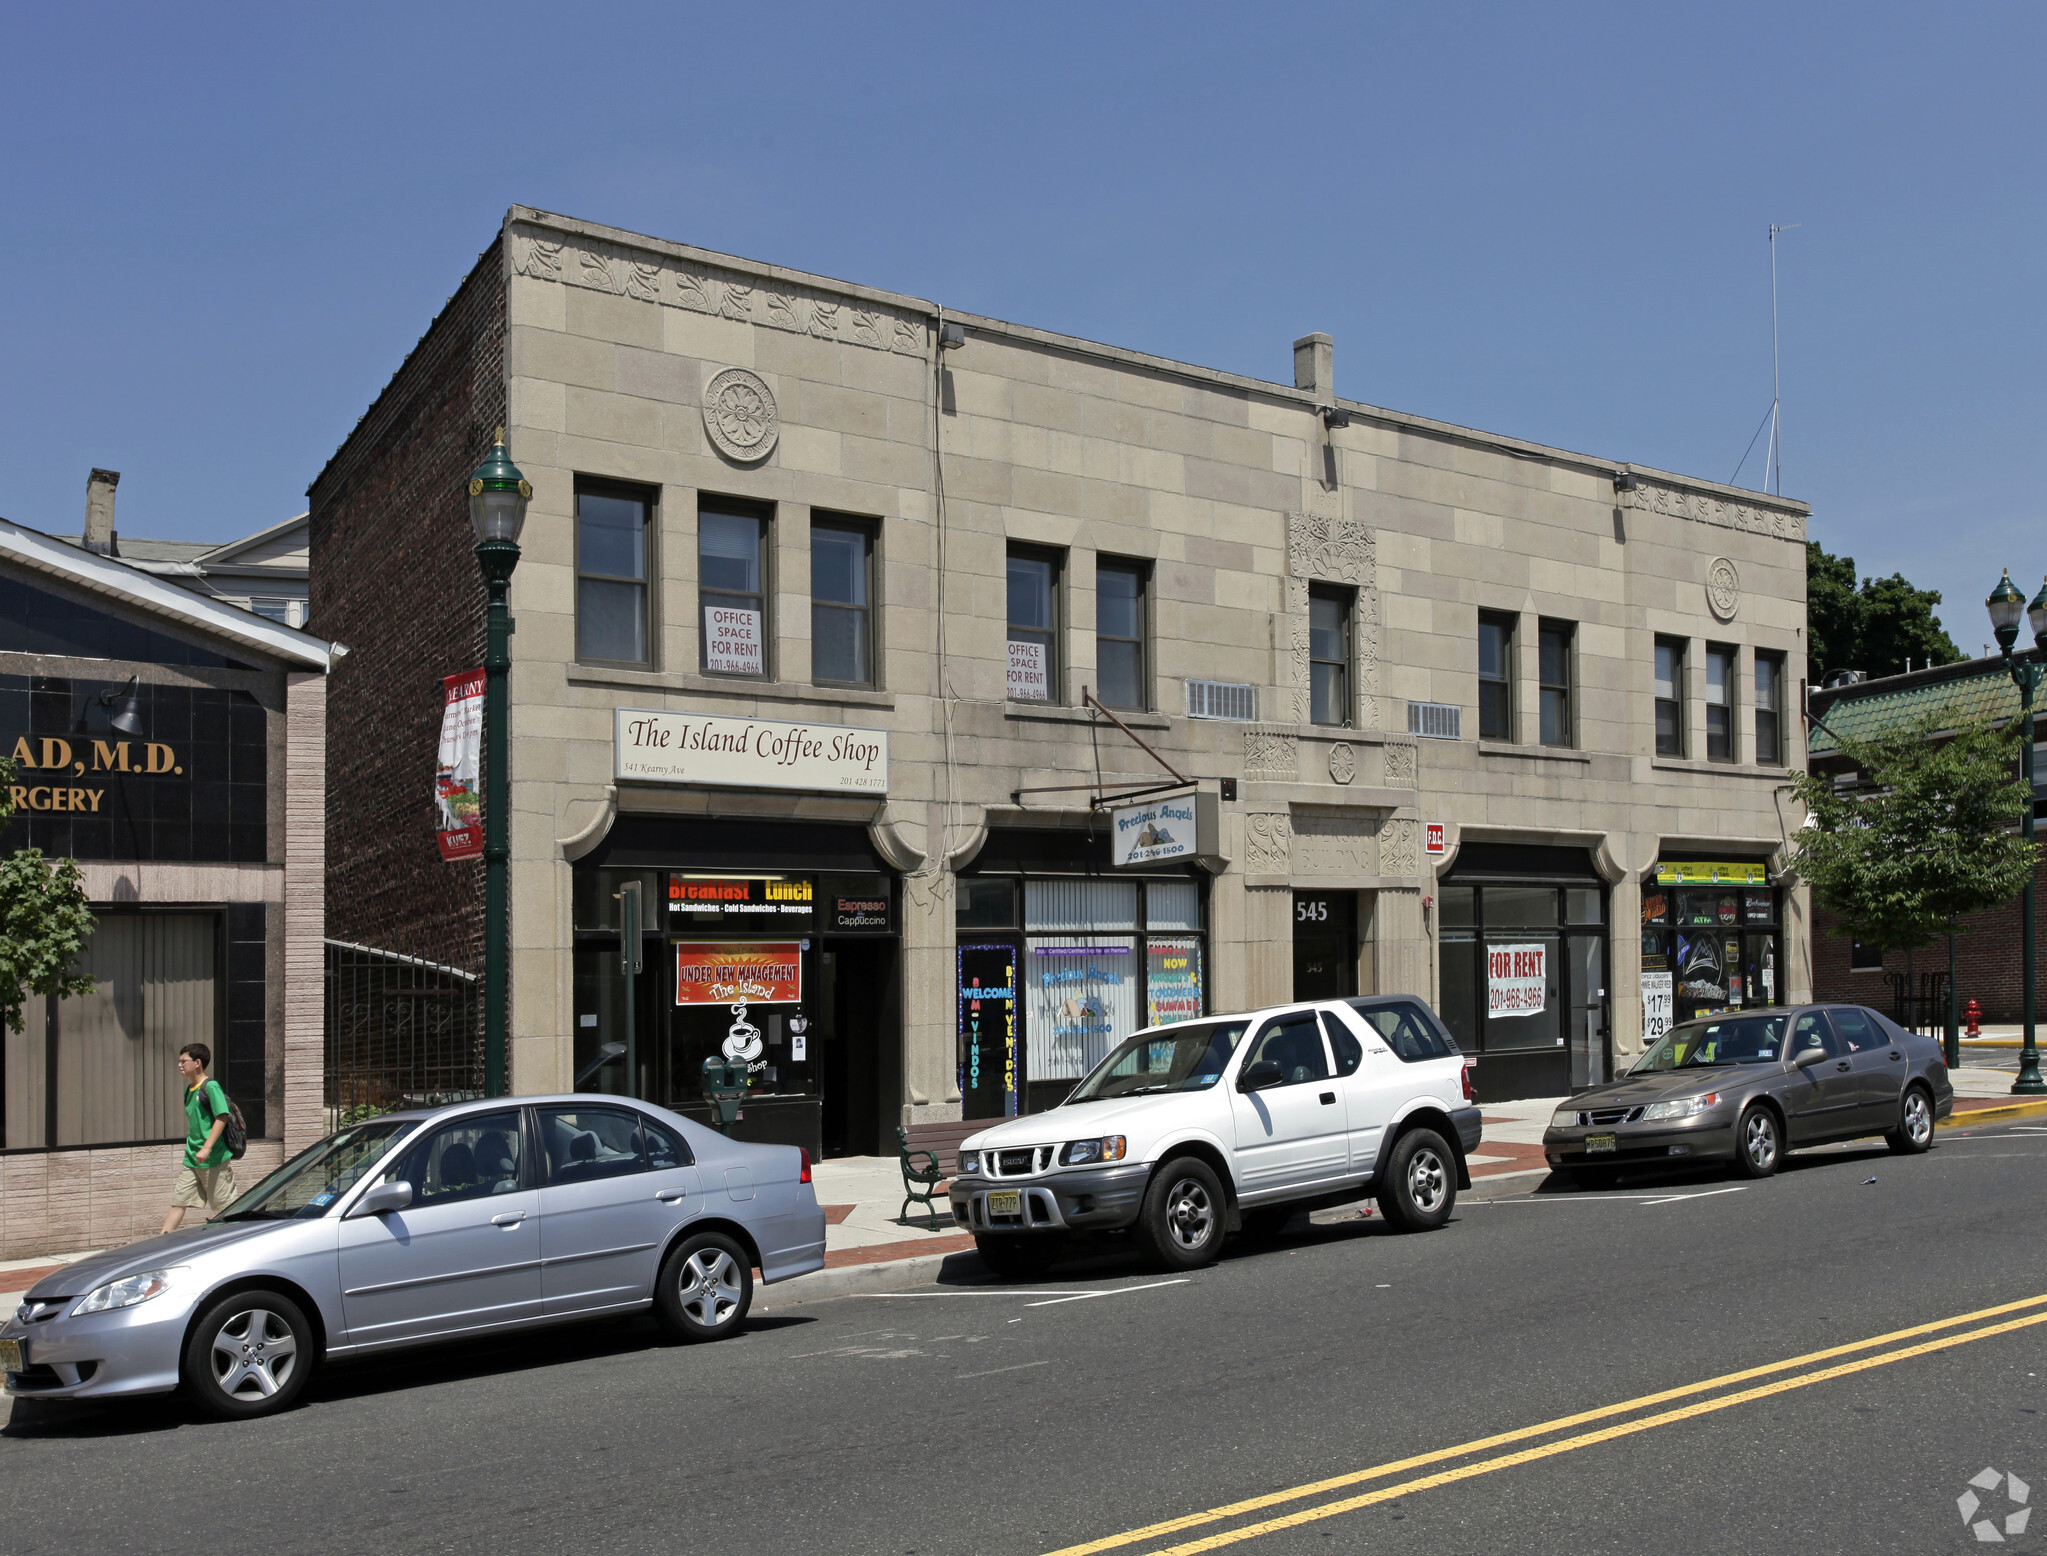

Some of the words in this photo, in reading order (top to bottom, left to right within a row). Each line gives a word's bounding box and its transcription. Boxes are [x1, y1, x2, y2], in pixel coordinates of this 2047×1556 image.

[714, 611, 752, 625] OFFICE
[718, 627, 751, 639] SPACE
[712, 641, 731, 655] FOR
[735, 643, 758, 656] RENT
[1008, 644, 1038, 657] OFFICE
[1011, 658, 1037, 668] SPACE
[1007, 670, 1022, 682] FOR
[1025, 672, 1043, 684] RENT
[628, 718, 670, 748] The
[678, 722, 753, 753] Island
[756, 728, 823, 766] Coffee
[827, 733, 879, 771] Shop
[90, 740, 183, 775] M.D.
[624, 762, 638, 771] 541
[639, 763, 669, 775] Kearny
[669, 765, 685, 774] Ave
[840, 776, 853, 785] 201
[854, 777, 868, 786] 428
[869, 778, 885, 787] 1771
[5, 785, 104, 812] RGERY
[1118, 811, 1156, 832] Precious
[1160, 805, 1193, 820] Angels
[1428, 831, 1443, 845] F.D.C.
[669, 878, 749, 900] Breakfast
[765, 880, 812, 901] Lunch
[669, 903, 680, 912] Hot
[681, 903, 719, 912] Sandwiches
[725, 904, 738, 912] Cold
[740, 904, 776, 913] Sandwiches
[781, 905, 812, 914] Beverages
[838, 899, 885, 912] Espresso
[1297, 902, 1327, 921] 545
[838, 916, 885, 927] Cappuccino
[1694, 916, 1712, 924] ATM
[1149, 944, 1186, 955] ENROLL
[1164, 958, 1187, 969] NOW
[1307, 963, 1323, 972] 545
[1490, 952, 1511, 978] FOR
[1514, 951, 1543, 977] RENT
[681, 965, 712, 982] UNDER
[715, 965, 735, 981] NEW
[737, 964, 797, 981] MANAGEMENT
[1042, 967, 1084, 987] Precious
[709, 982, 734, 1000] The
[739, 979, 775, 1000] Island
[962, 988, 1012, 999] WELCOME
[1149, 987, 1199, 999] TODDLERS
[1490, 987, 1541, 1009] 201-966-4966
[1002, 1157, 1025, 1166] ISUZU
